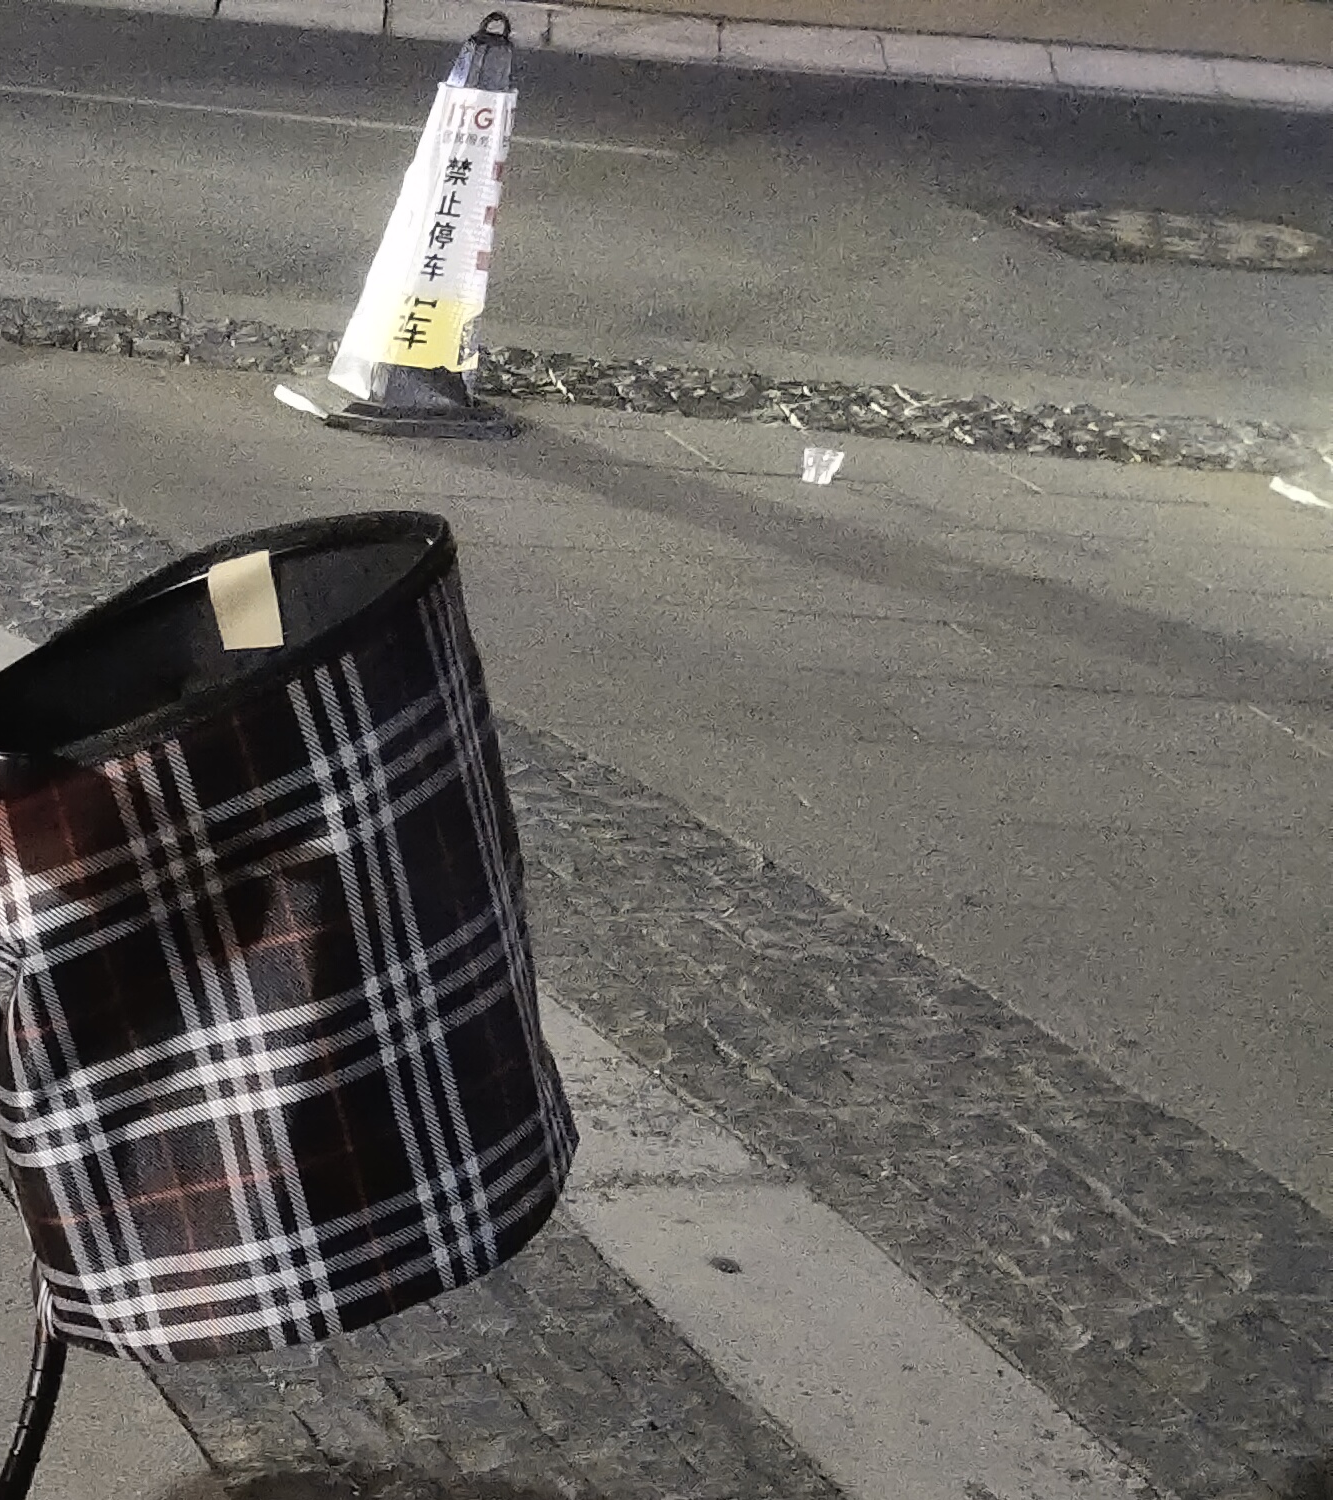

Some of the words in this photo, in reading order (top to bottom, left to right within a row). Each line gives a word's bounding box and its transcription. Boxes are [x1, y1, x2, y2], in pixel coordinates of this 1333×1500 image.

[446, 101, 494, 130] ITG
[421, 157, 473, 281] 禁止停车
